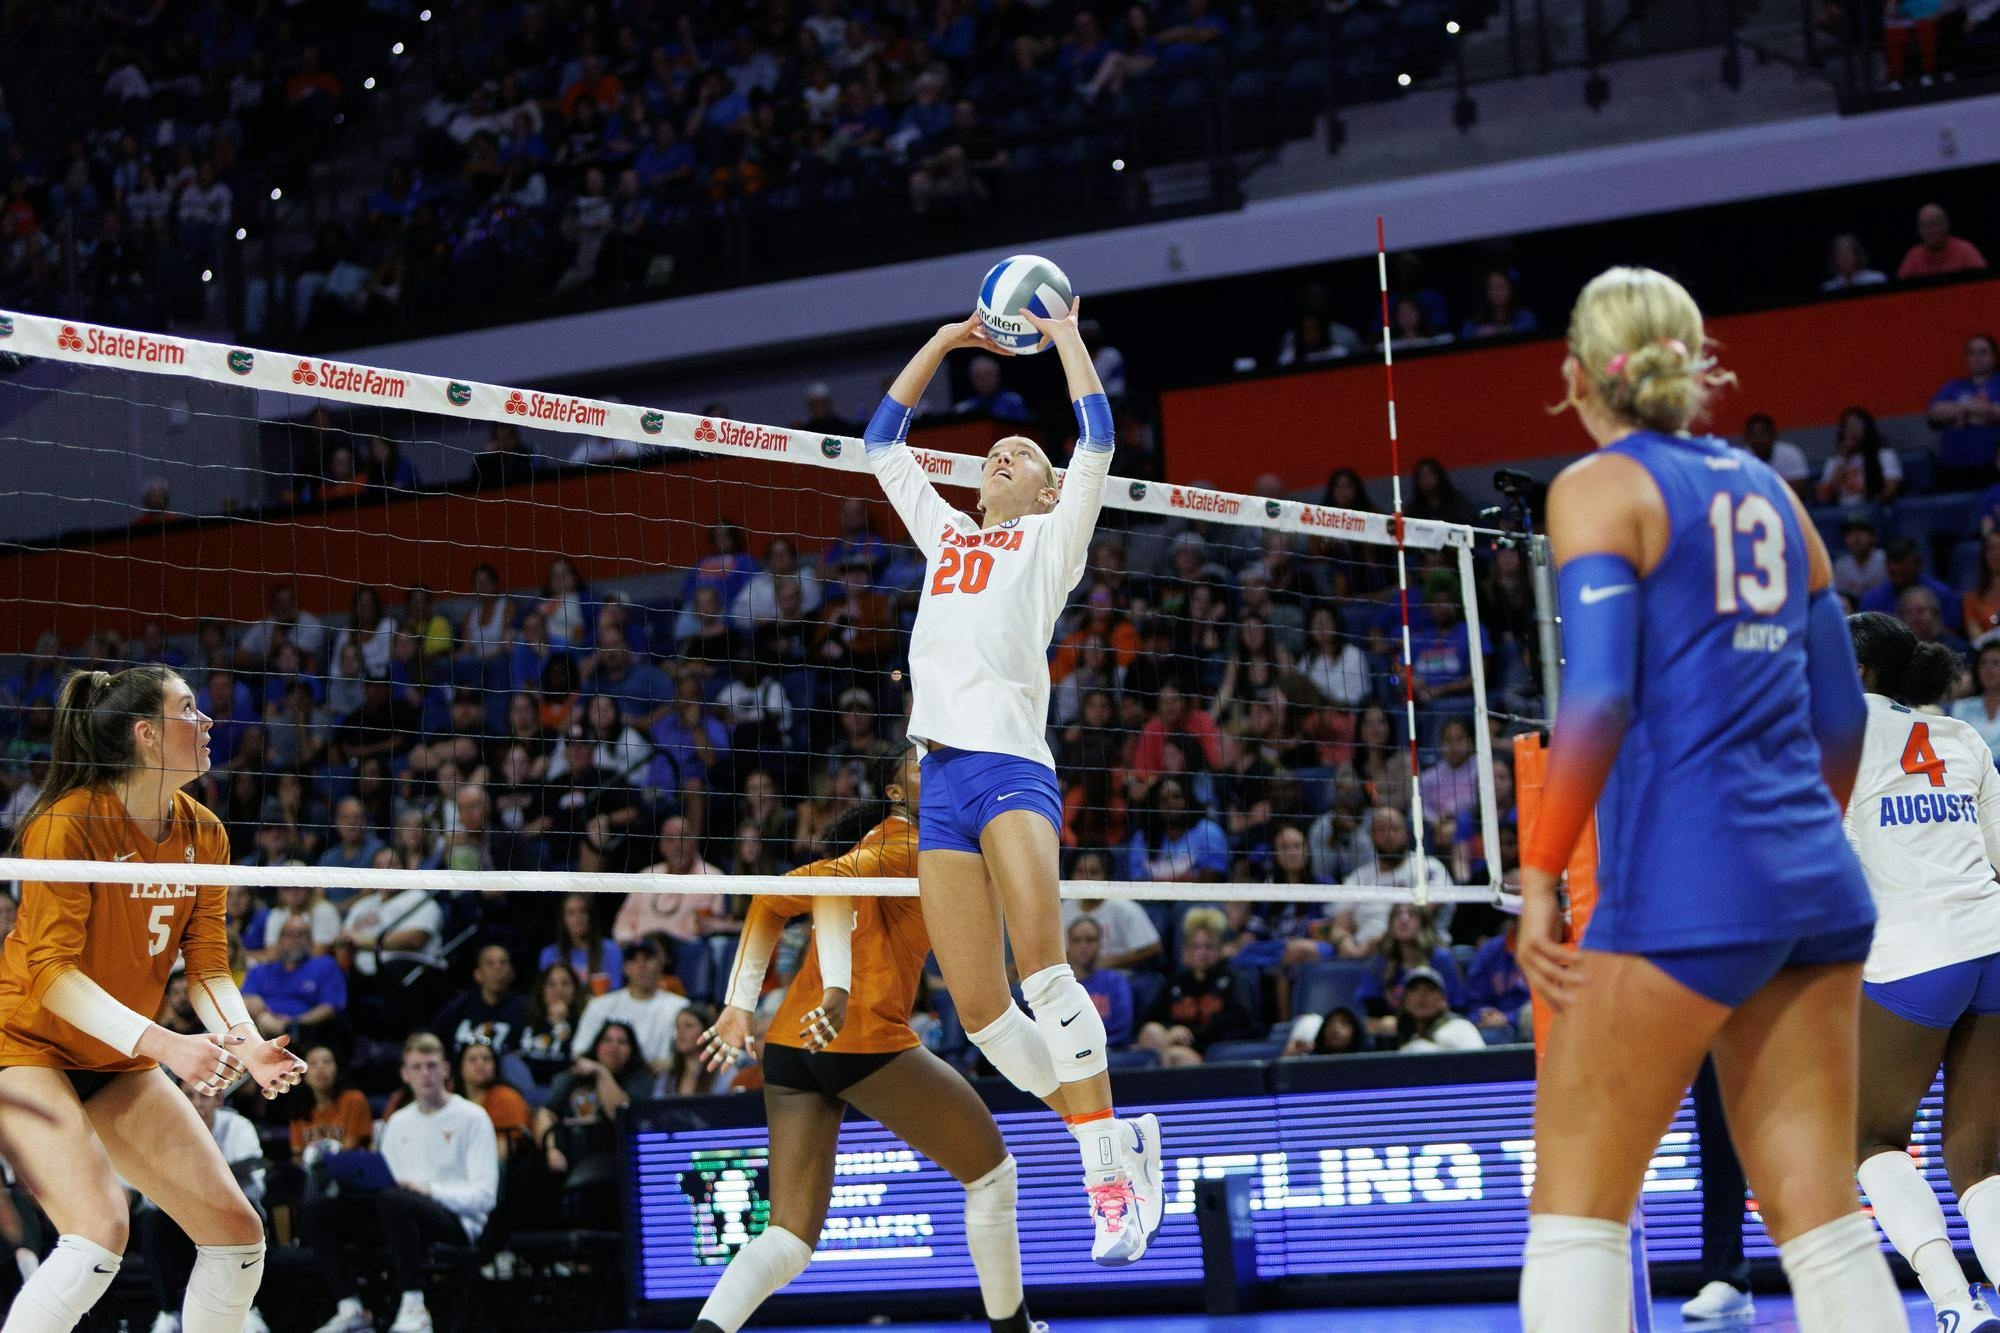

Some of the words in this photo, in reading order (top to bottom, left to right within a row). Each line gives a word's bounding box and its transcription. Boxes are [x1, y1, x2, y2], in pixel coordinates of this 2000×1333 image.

[979, 307, 1022, 333] molten
[930, 547, 996, 596] 20
[1708, 490, 1789, 616] 13
[1899, 721, 1948, 788] 4
[147, 905, 175, 957] 5
